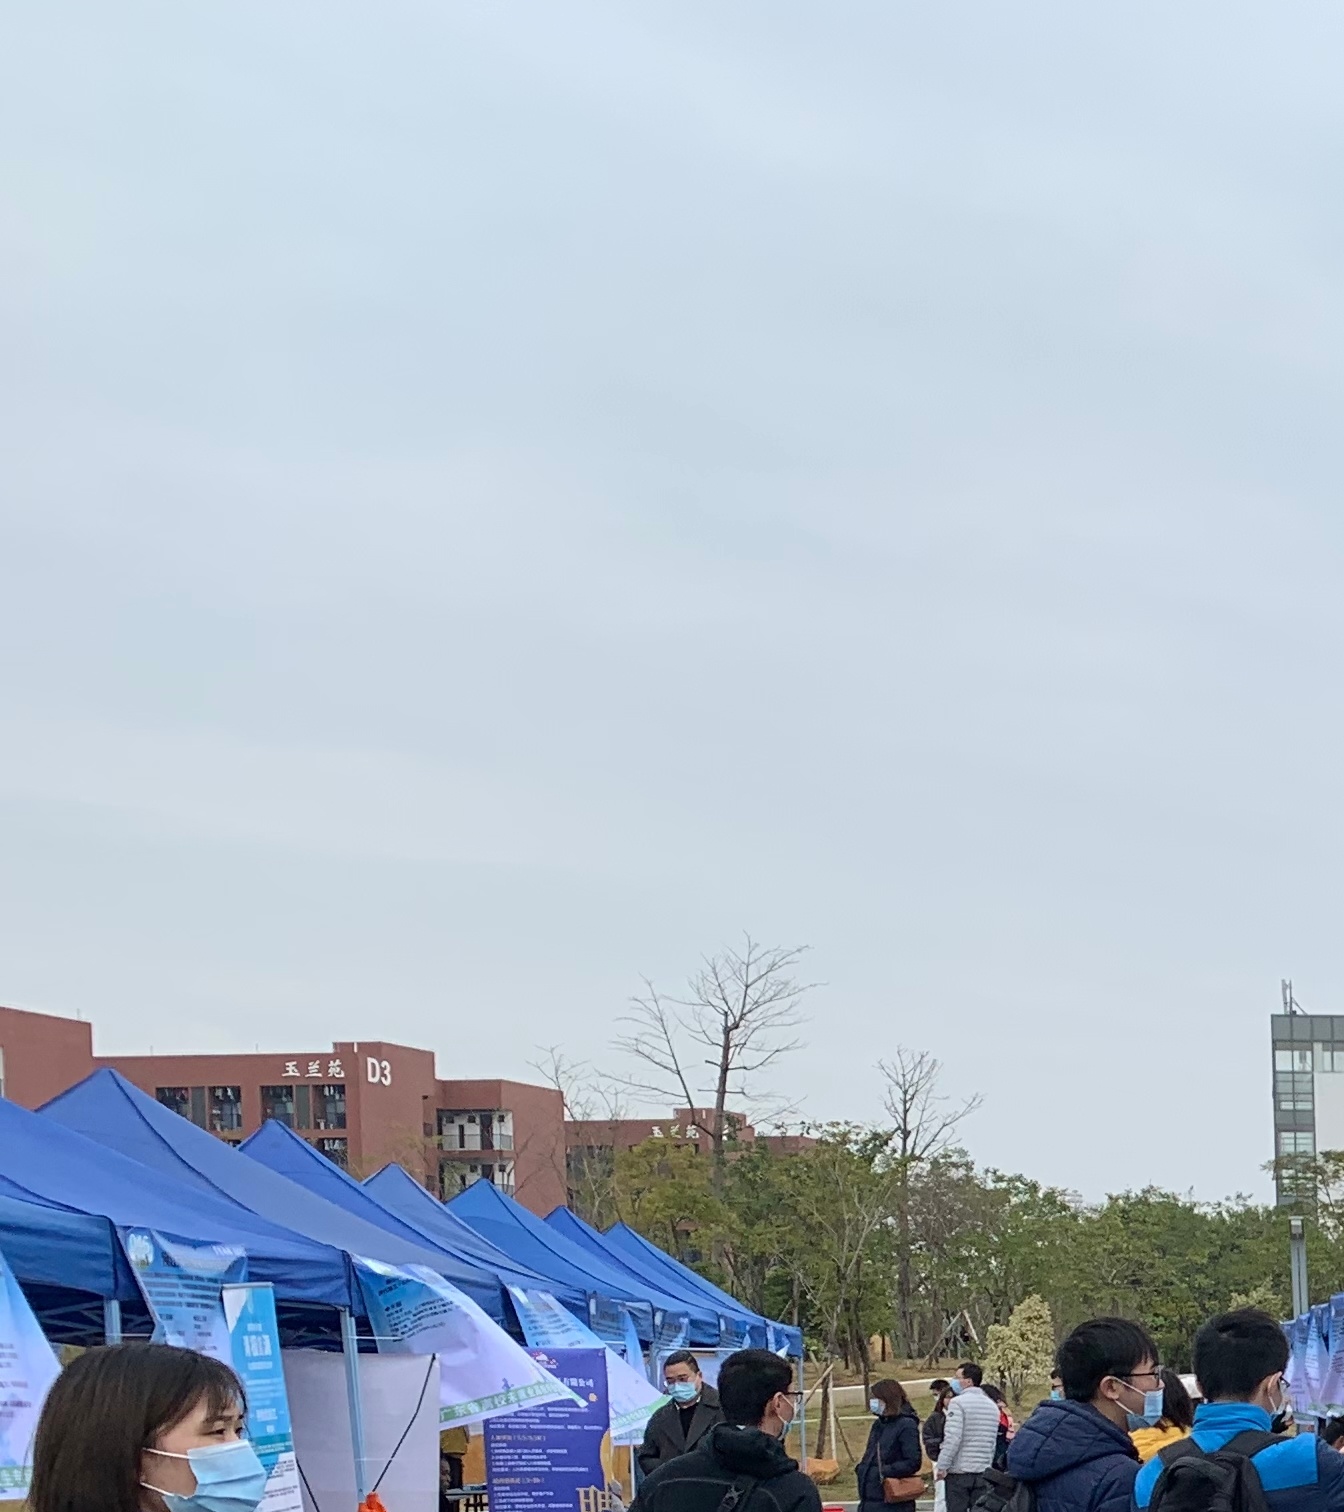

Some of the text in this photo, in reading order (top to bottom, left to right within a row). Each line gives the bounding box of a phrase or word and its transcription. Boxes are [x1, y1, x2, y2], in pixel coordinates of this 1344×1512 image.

[281, 1058, 345, 1078] 玉兰苑
[367, 1057, 391, 1086] D3
